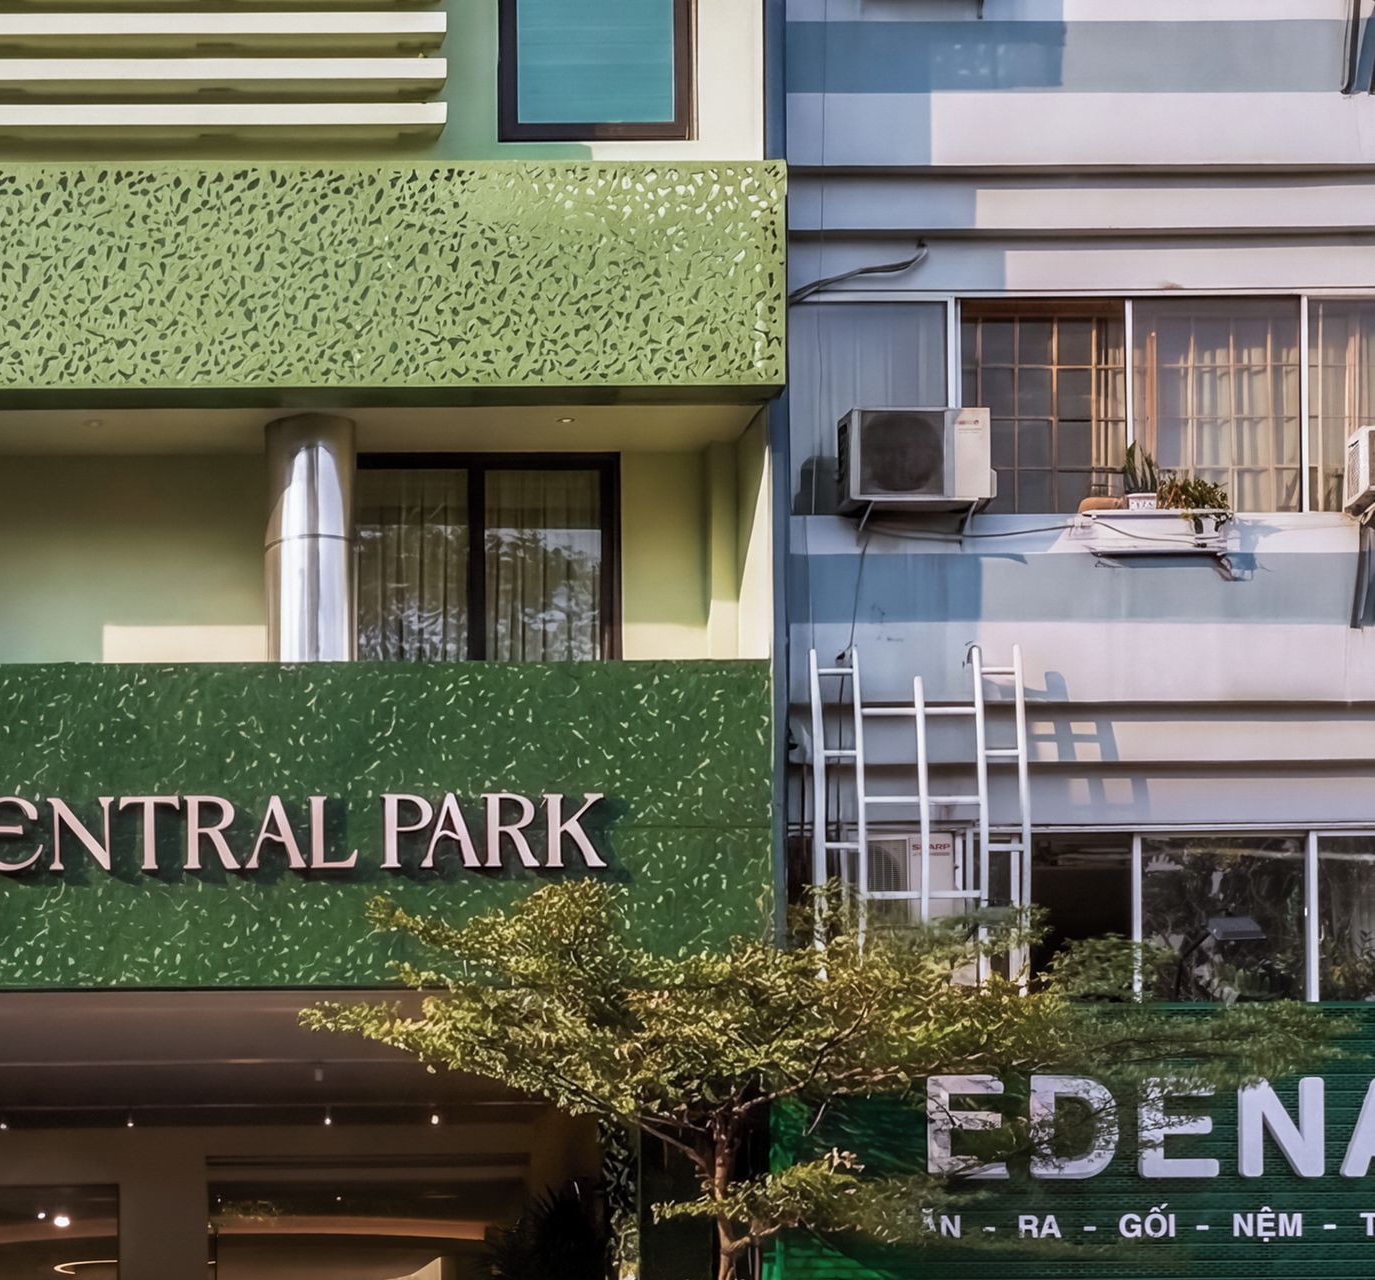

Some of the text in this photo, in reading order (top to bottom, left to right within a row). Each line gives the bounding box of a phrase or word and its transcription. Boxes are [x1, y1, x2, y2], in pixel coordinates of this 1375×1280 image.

[380, 791, 608, 869] PARK
[912, 843, 951, 851] SARP
[1019, 1214, 1062, 1238] RA
[1118, 1204, 1176, 1238] GỐI
[1233, 1206, 1303, 1242] NỆM
